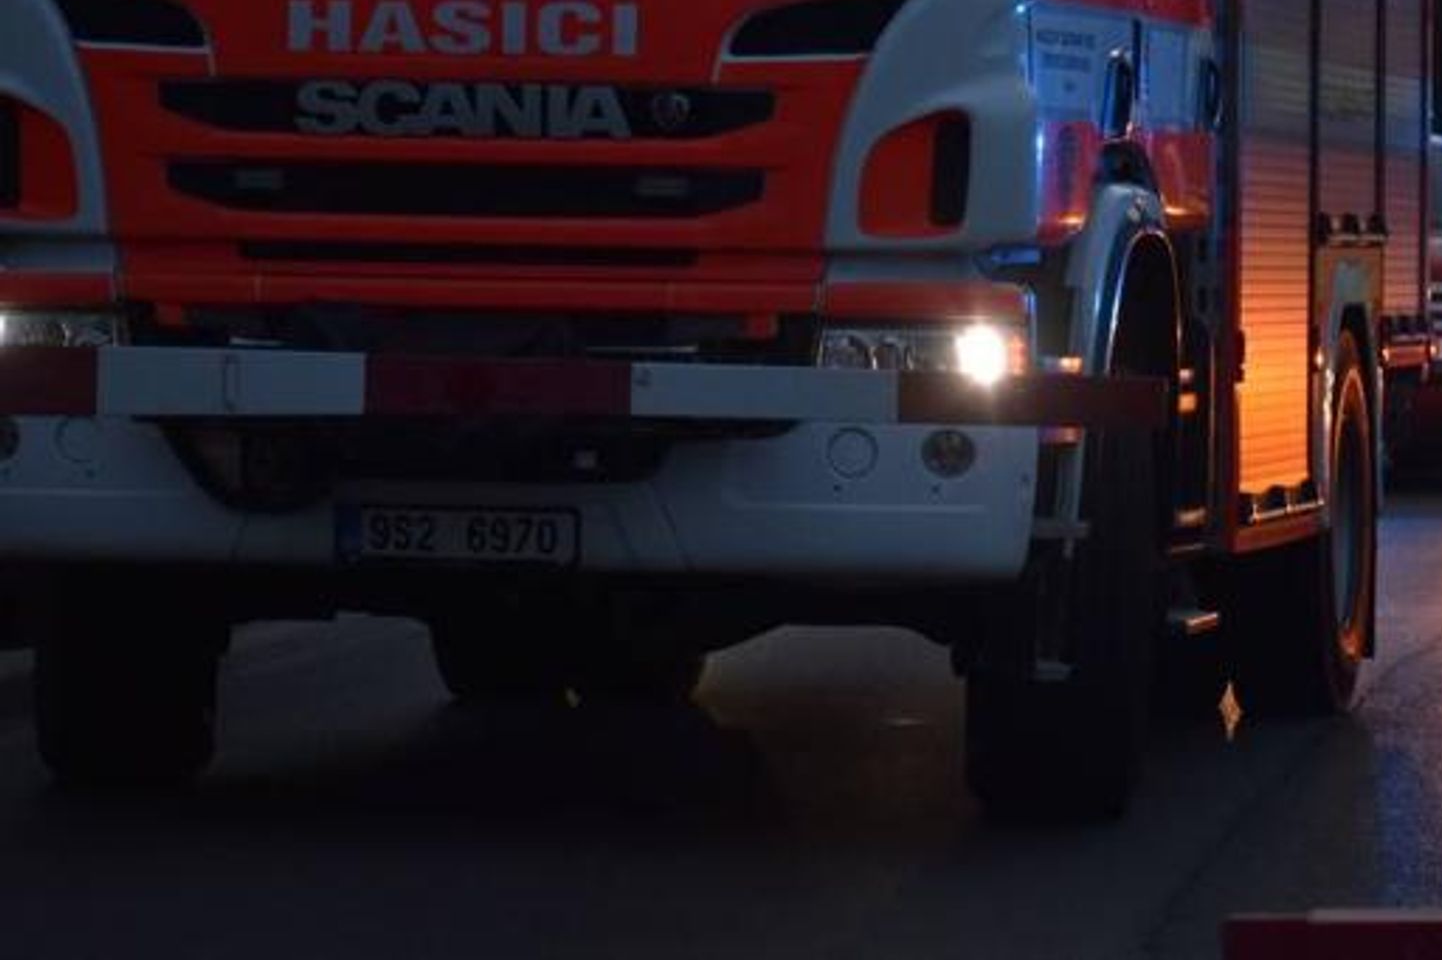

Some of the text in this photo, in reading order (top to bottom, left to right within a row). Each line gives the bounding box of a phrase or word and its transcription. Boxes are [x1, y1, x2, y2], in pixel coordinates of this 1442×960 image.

[294, 79, 632, 139] SCANIA
[369, 513, 557, 554] 9S2 6970
